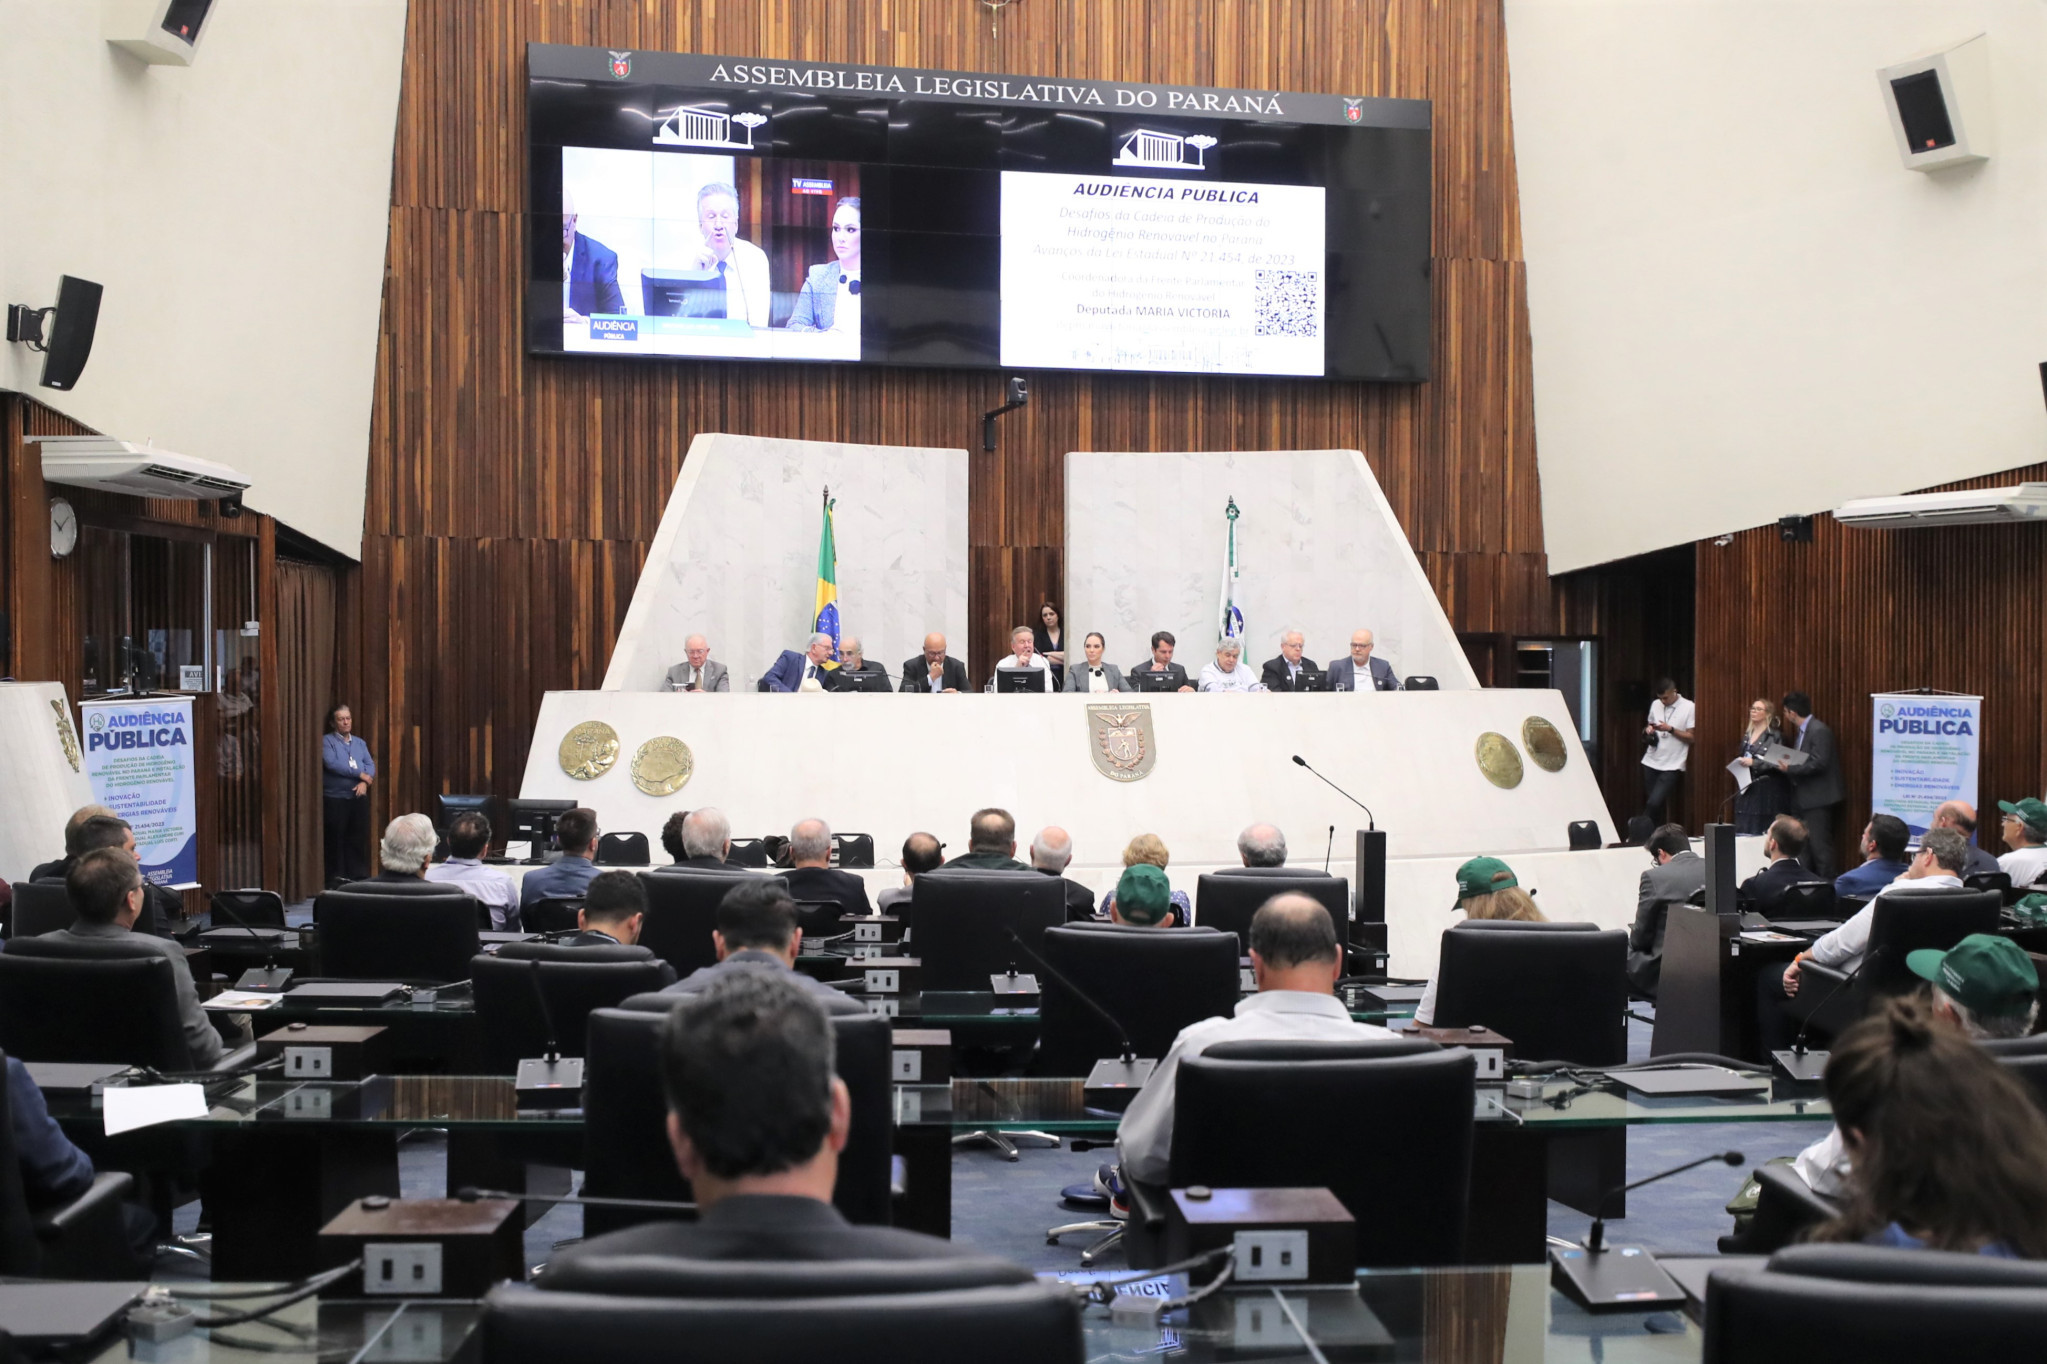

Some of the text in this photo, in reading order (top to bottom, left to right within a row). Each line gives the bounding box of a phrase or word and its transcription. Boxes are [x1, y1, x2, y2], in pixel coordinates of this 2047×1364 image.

[709, 63, 1285, 115] ASSEMBLEIA LEGISLATIVA DO PARANÁ
[792, 179, 802, 188] TV
[1059, 206, 1271, 228] Desafios da Cadeia de Produção do
[1202, 233, 1217, 243] no
[1105, 247, 1123, 258] Lei
[1126, 248, 1178, 261] Estadual
[1247, 252, 1262, 264] de
[1265, 254, 1295, 265] 2023
[1076, 303, 1231, 319] Deputada MARIA VICTORIA
[592, 320, 636, 332] AUDIÊNCIA
[1897, 705, 1972, 718] AUDIÊNCIA
[108, 711, 185, 728] AUDIÊNCIA
[1879, 717, 1974, 736] PÚBLICA
[89, 727, 187, 752] PÚBLICA
[108, 792, 141, 801] INOVAÇÃO
[108, 799, 167, 810] SUSTENTABILIDADE
[117, 806, 177, 818] ERGIAS RENOVÁVEIS
